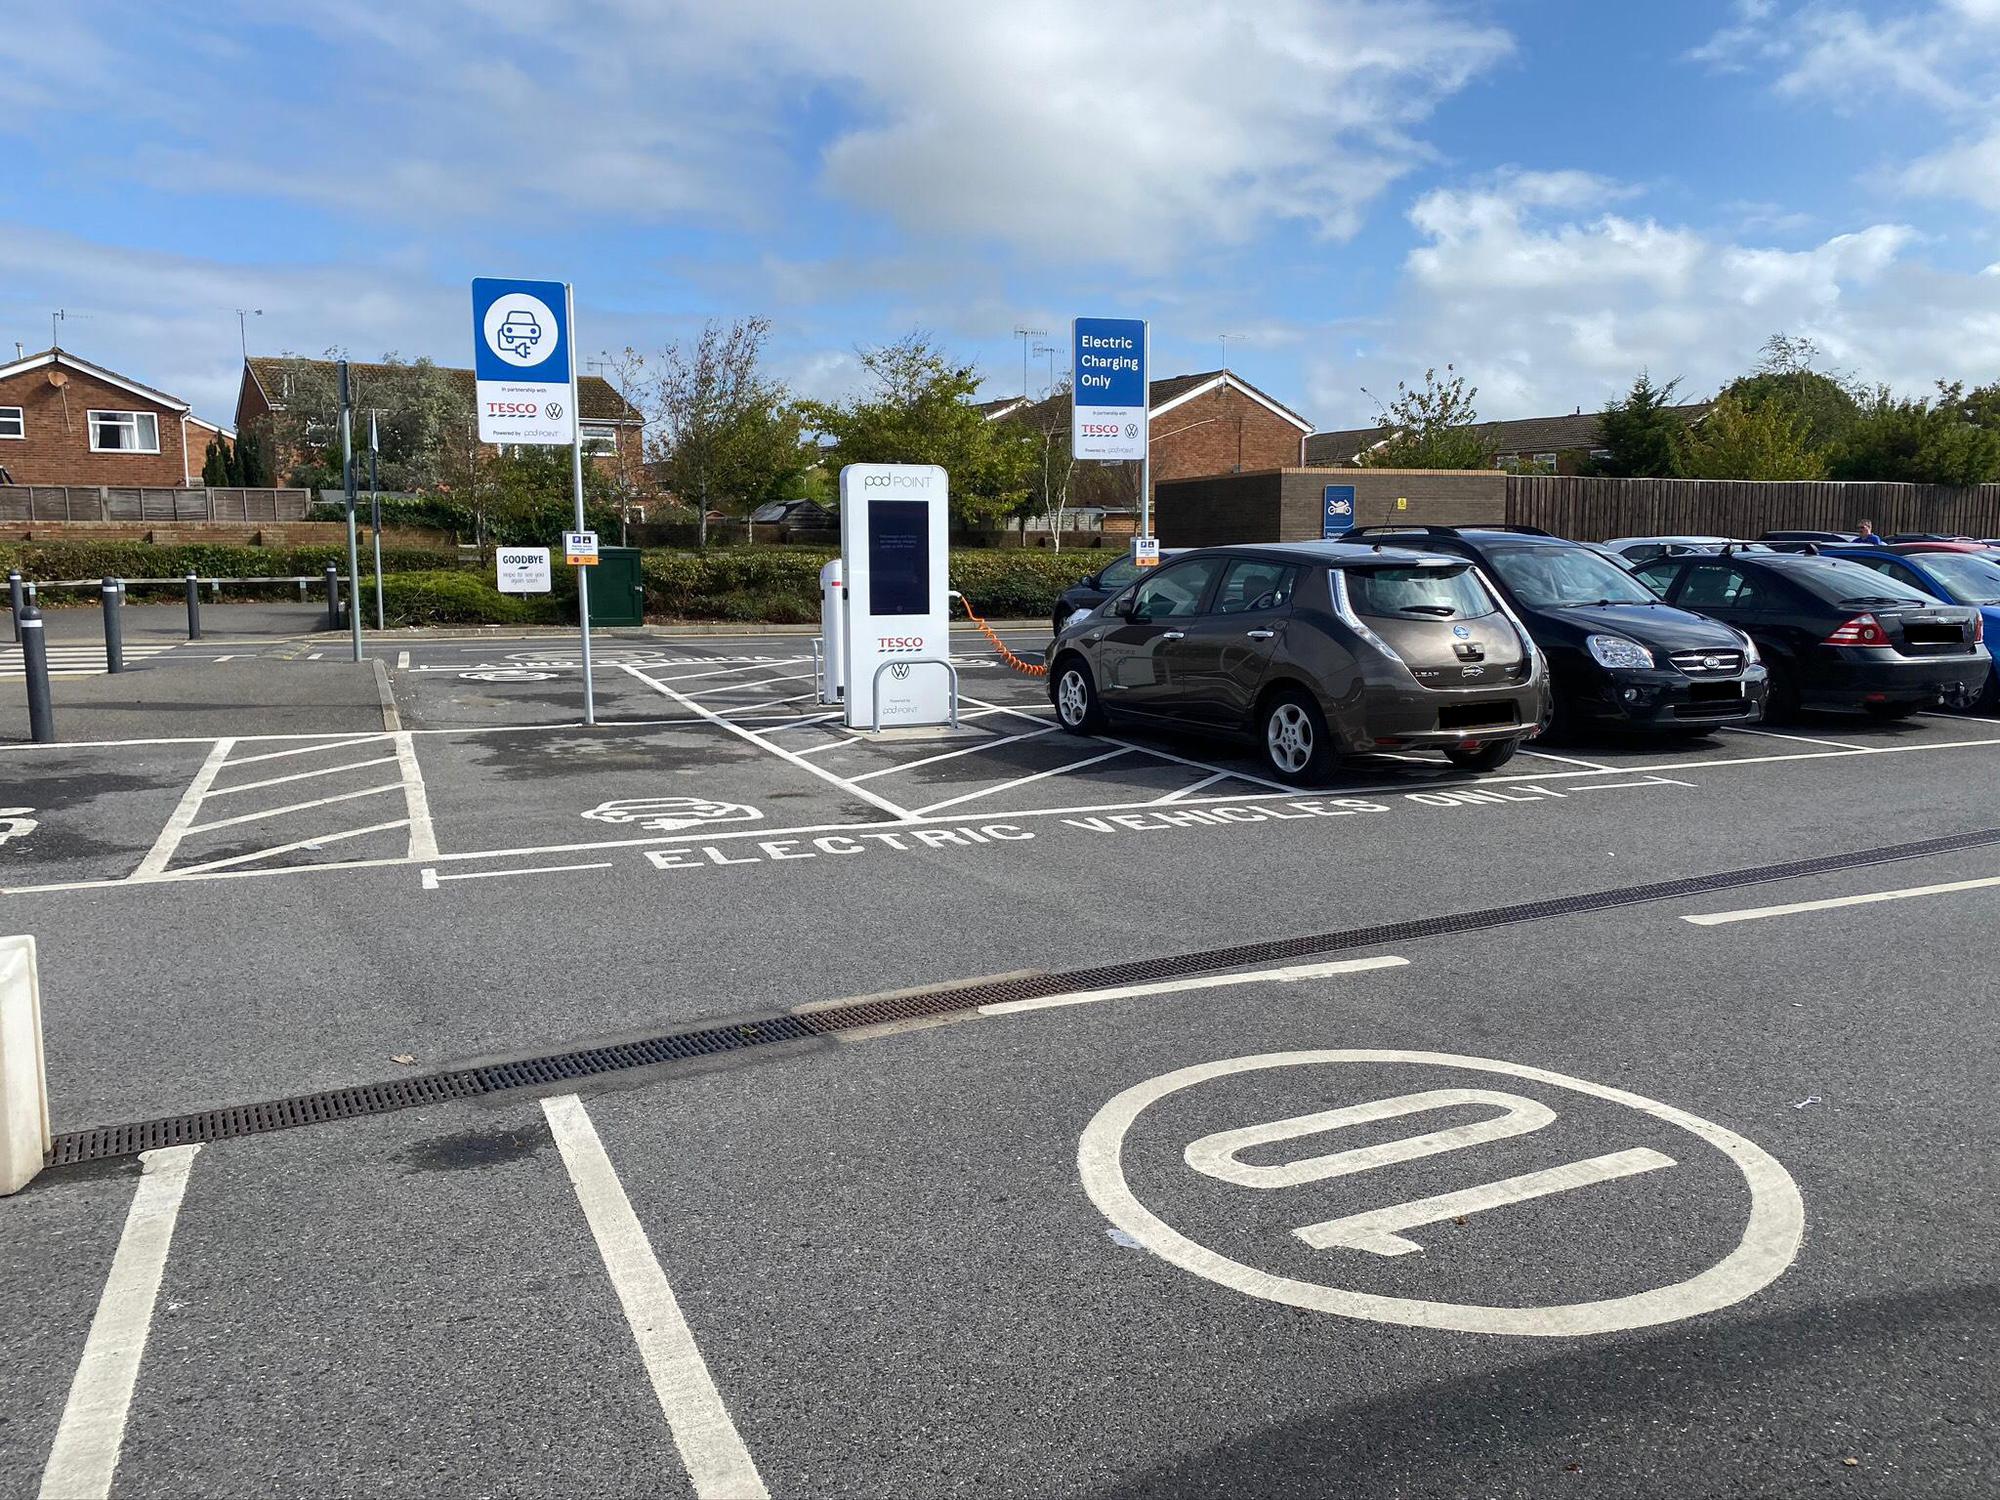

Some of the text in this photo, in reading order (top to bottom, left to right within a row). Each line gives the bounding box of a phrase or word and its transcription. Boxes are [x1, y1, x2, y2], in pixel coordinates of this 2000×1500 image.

[1081, 335, 1133, 349] Electric
[1081, 355, 1139, 371] Charging
[1081, 374, 1111, 389] Only
[486, 402, 537, 413] TESCO
[1081, 424, 1119, 433] TESCO
[865, 472, 933, 490] pod POINT
[502, 555, 544, 564] GOODBYE
[878, 637, 923, 648] TESCO
[1404, 784, 1568, 808] ONLY
[1060, 799, 1392, 833] VEHICLES
[643, 824, 1036, 869] ELECTRIC
[1184, 1088, 1678, 1257] 10
